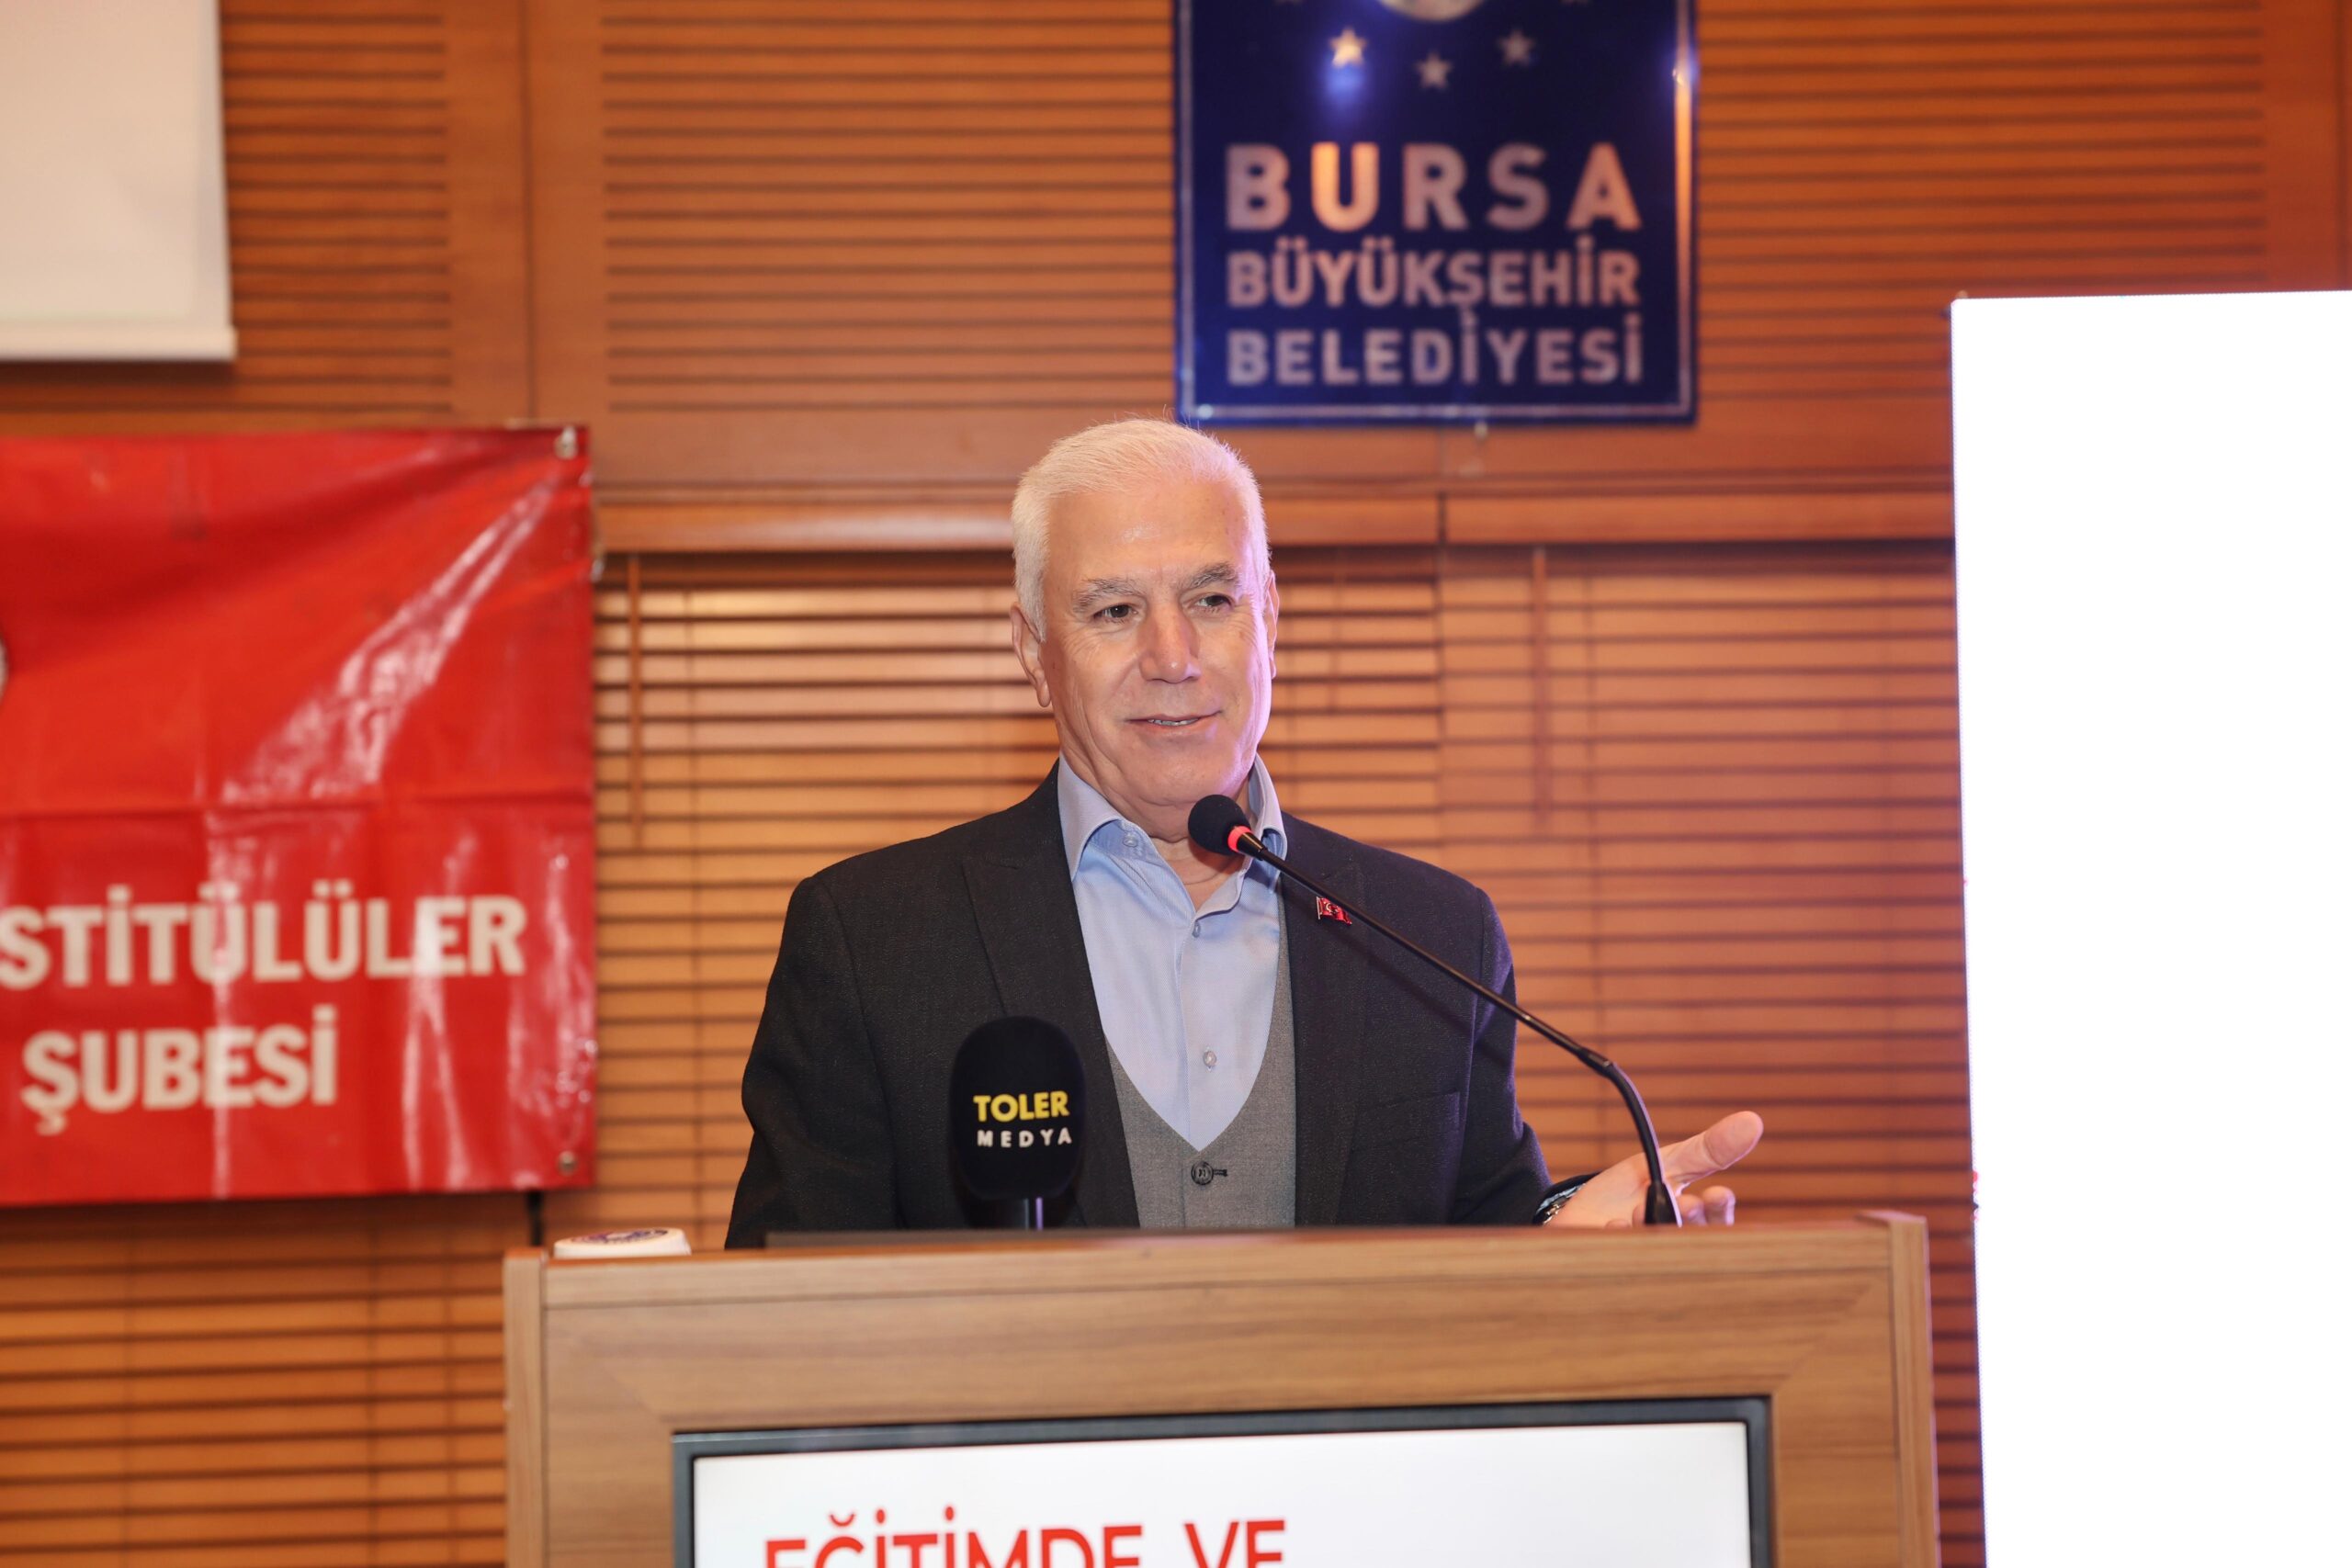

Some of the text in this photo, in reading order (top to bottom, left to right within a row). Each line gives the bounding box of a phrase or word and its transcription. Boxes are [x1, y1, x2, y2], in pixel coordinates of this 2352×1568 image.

[1226, 141, 1642, 231] BURSA
[1227, 236, 1641, 315] BÜYÜKŞEHİR
[1227, 313, 1643, 386] BELEDİYESİ
[0, 879, 528, 989] STİTÜLÜLER
[22, 1005, 338, 1135] ŞUBESİ
[973, 1090, 1070, 1122] TOLER
[977, 1127, 1072, 1148] MEDYA
[1184, 1520, 1285, 1568] VE
